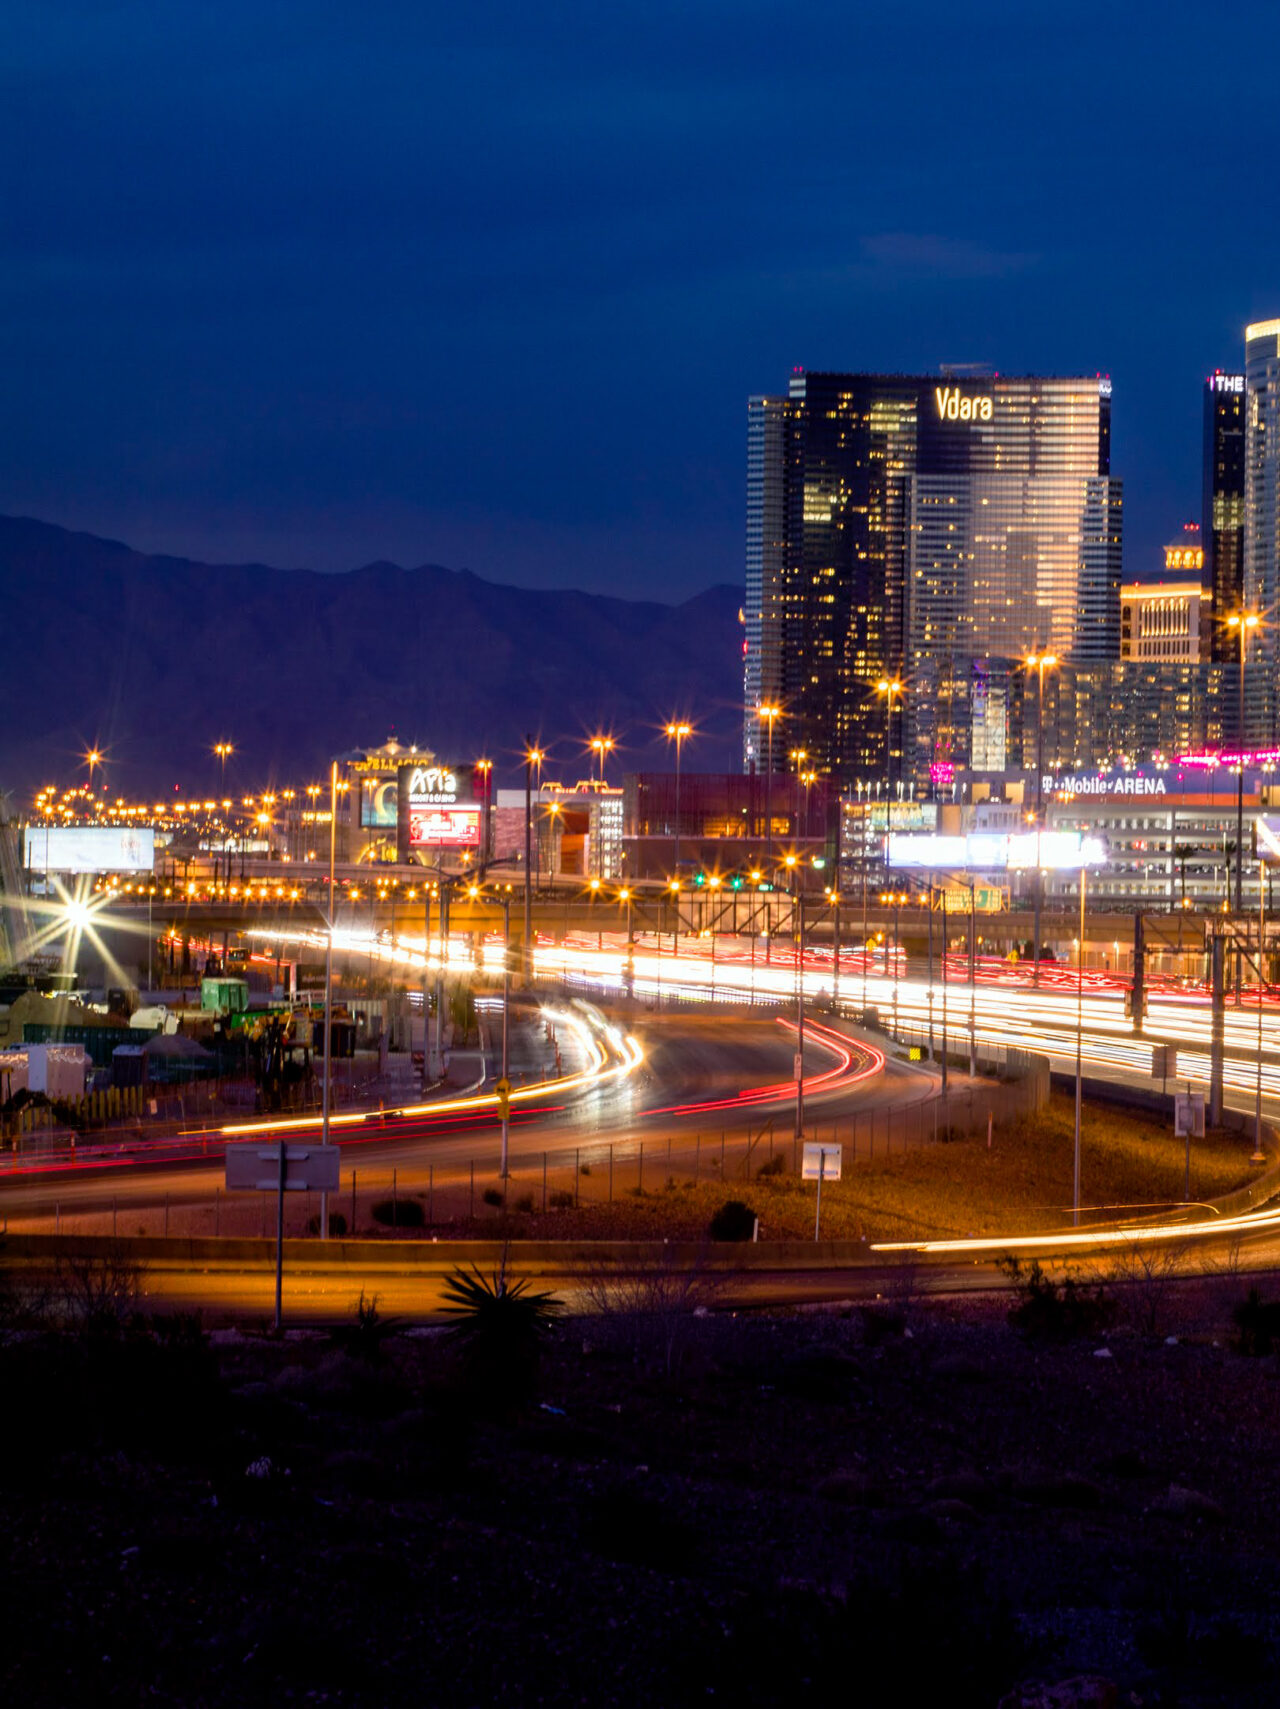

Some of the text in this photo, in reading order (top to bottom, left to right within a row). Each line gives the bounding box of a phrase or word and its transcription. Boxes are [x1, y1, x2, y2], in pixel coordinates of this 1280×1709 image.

[1216, 376, 1244, 392] THE
[936, 386, 993, 421] Vdara
[410, 767, 457, 793] Aria
[1114, 777, 1167, 795] ARENA
